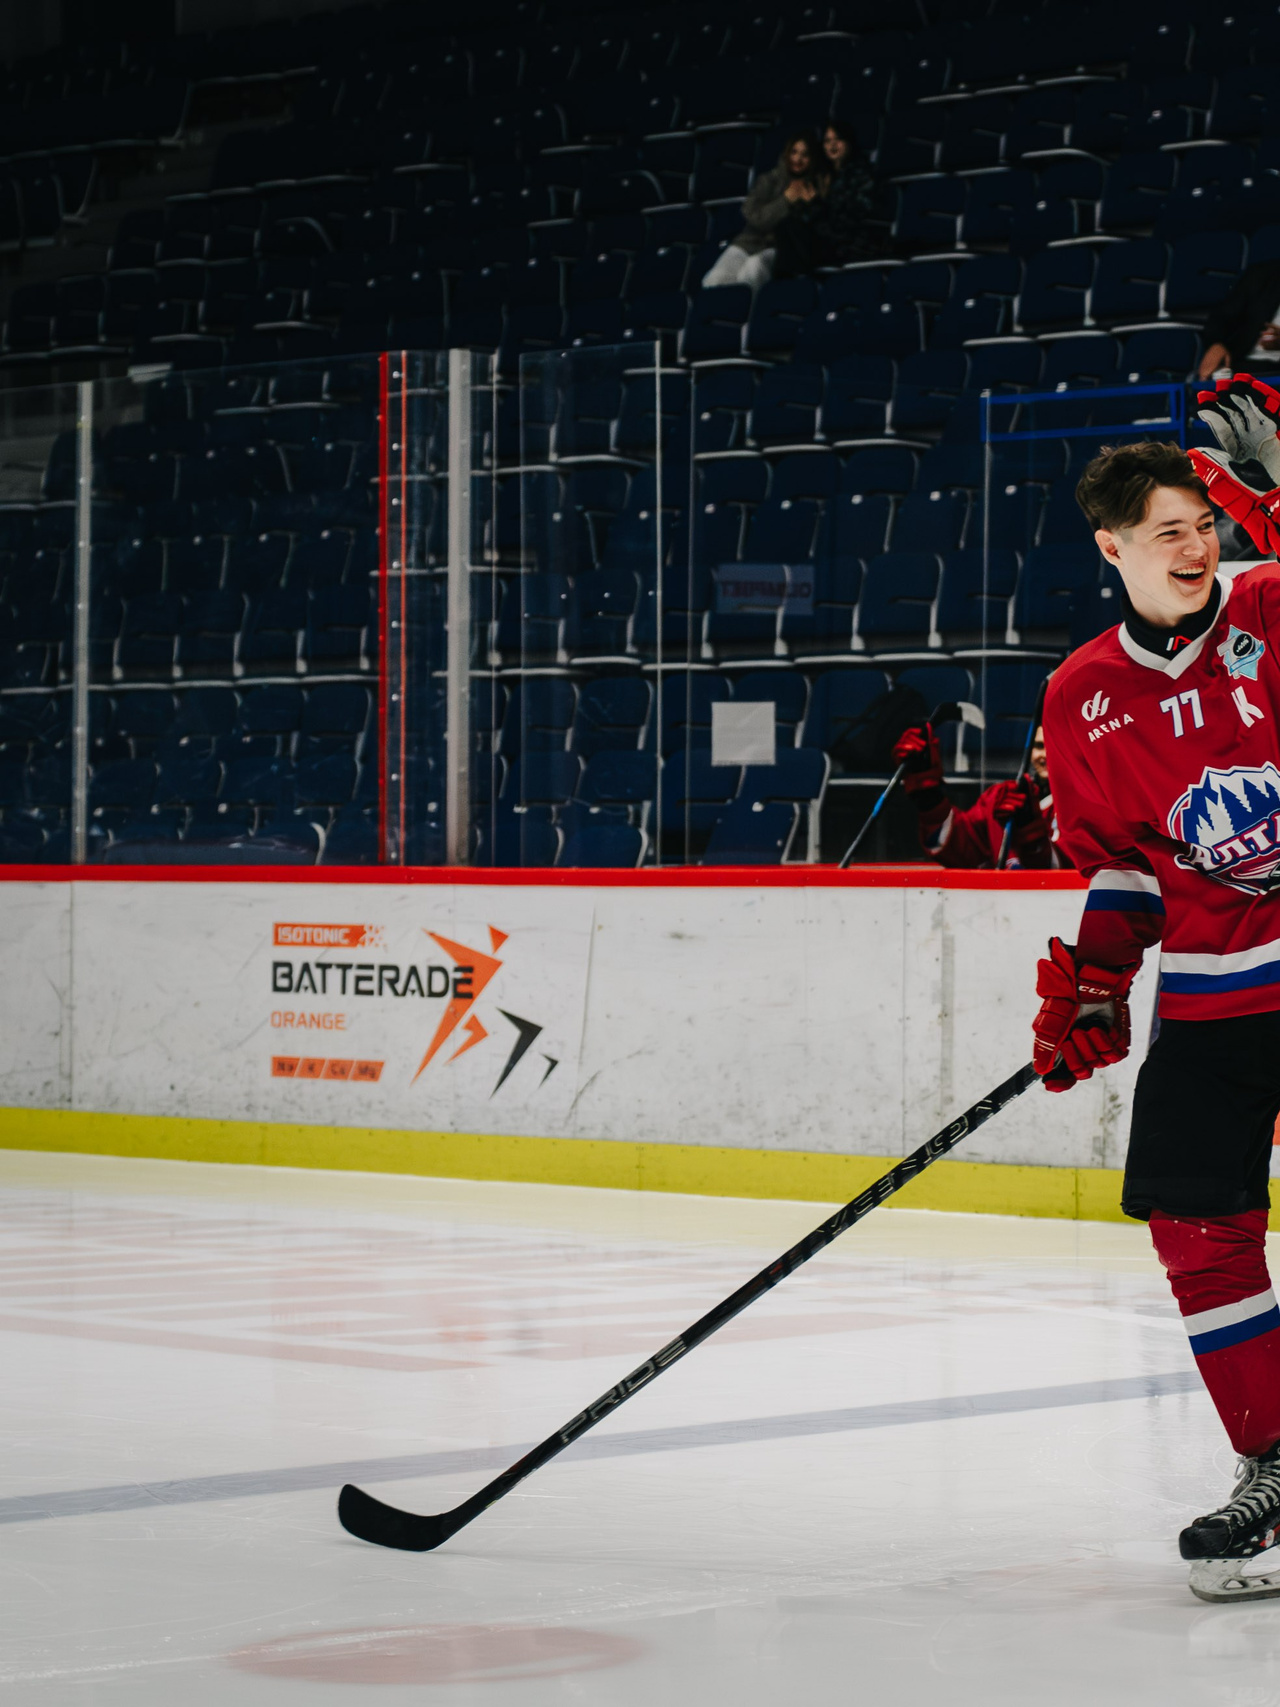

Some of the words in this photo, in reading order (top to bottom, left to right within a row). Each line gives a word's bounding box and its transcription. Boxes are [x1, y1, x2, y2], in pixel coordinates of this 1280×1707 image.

[1087, 713, 1134, 743] ARENA
[1159, 688, 1205, 738] 77
[278, 926, 350, 944] ISOTONIC
[272, 960, 474, 1000] BATTERADE
[1078, 985, 1111, 996] CCM
[270, 1010, 347, 1031] ORANGE
[560, 1335, 687, 1444] PRIDE
